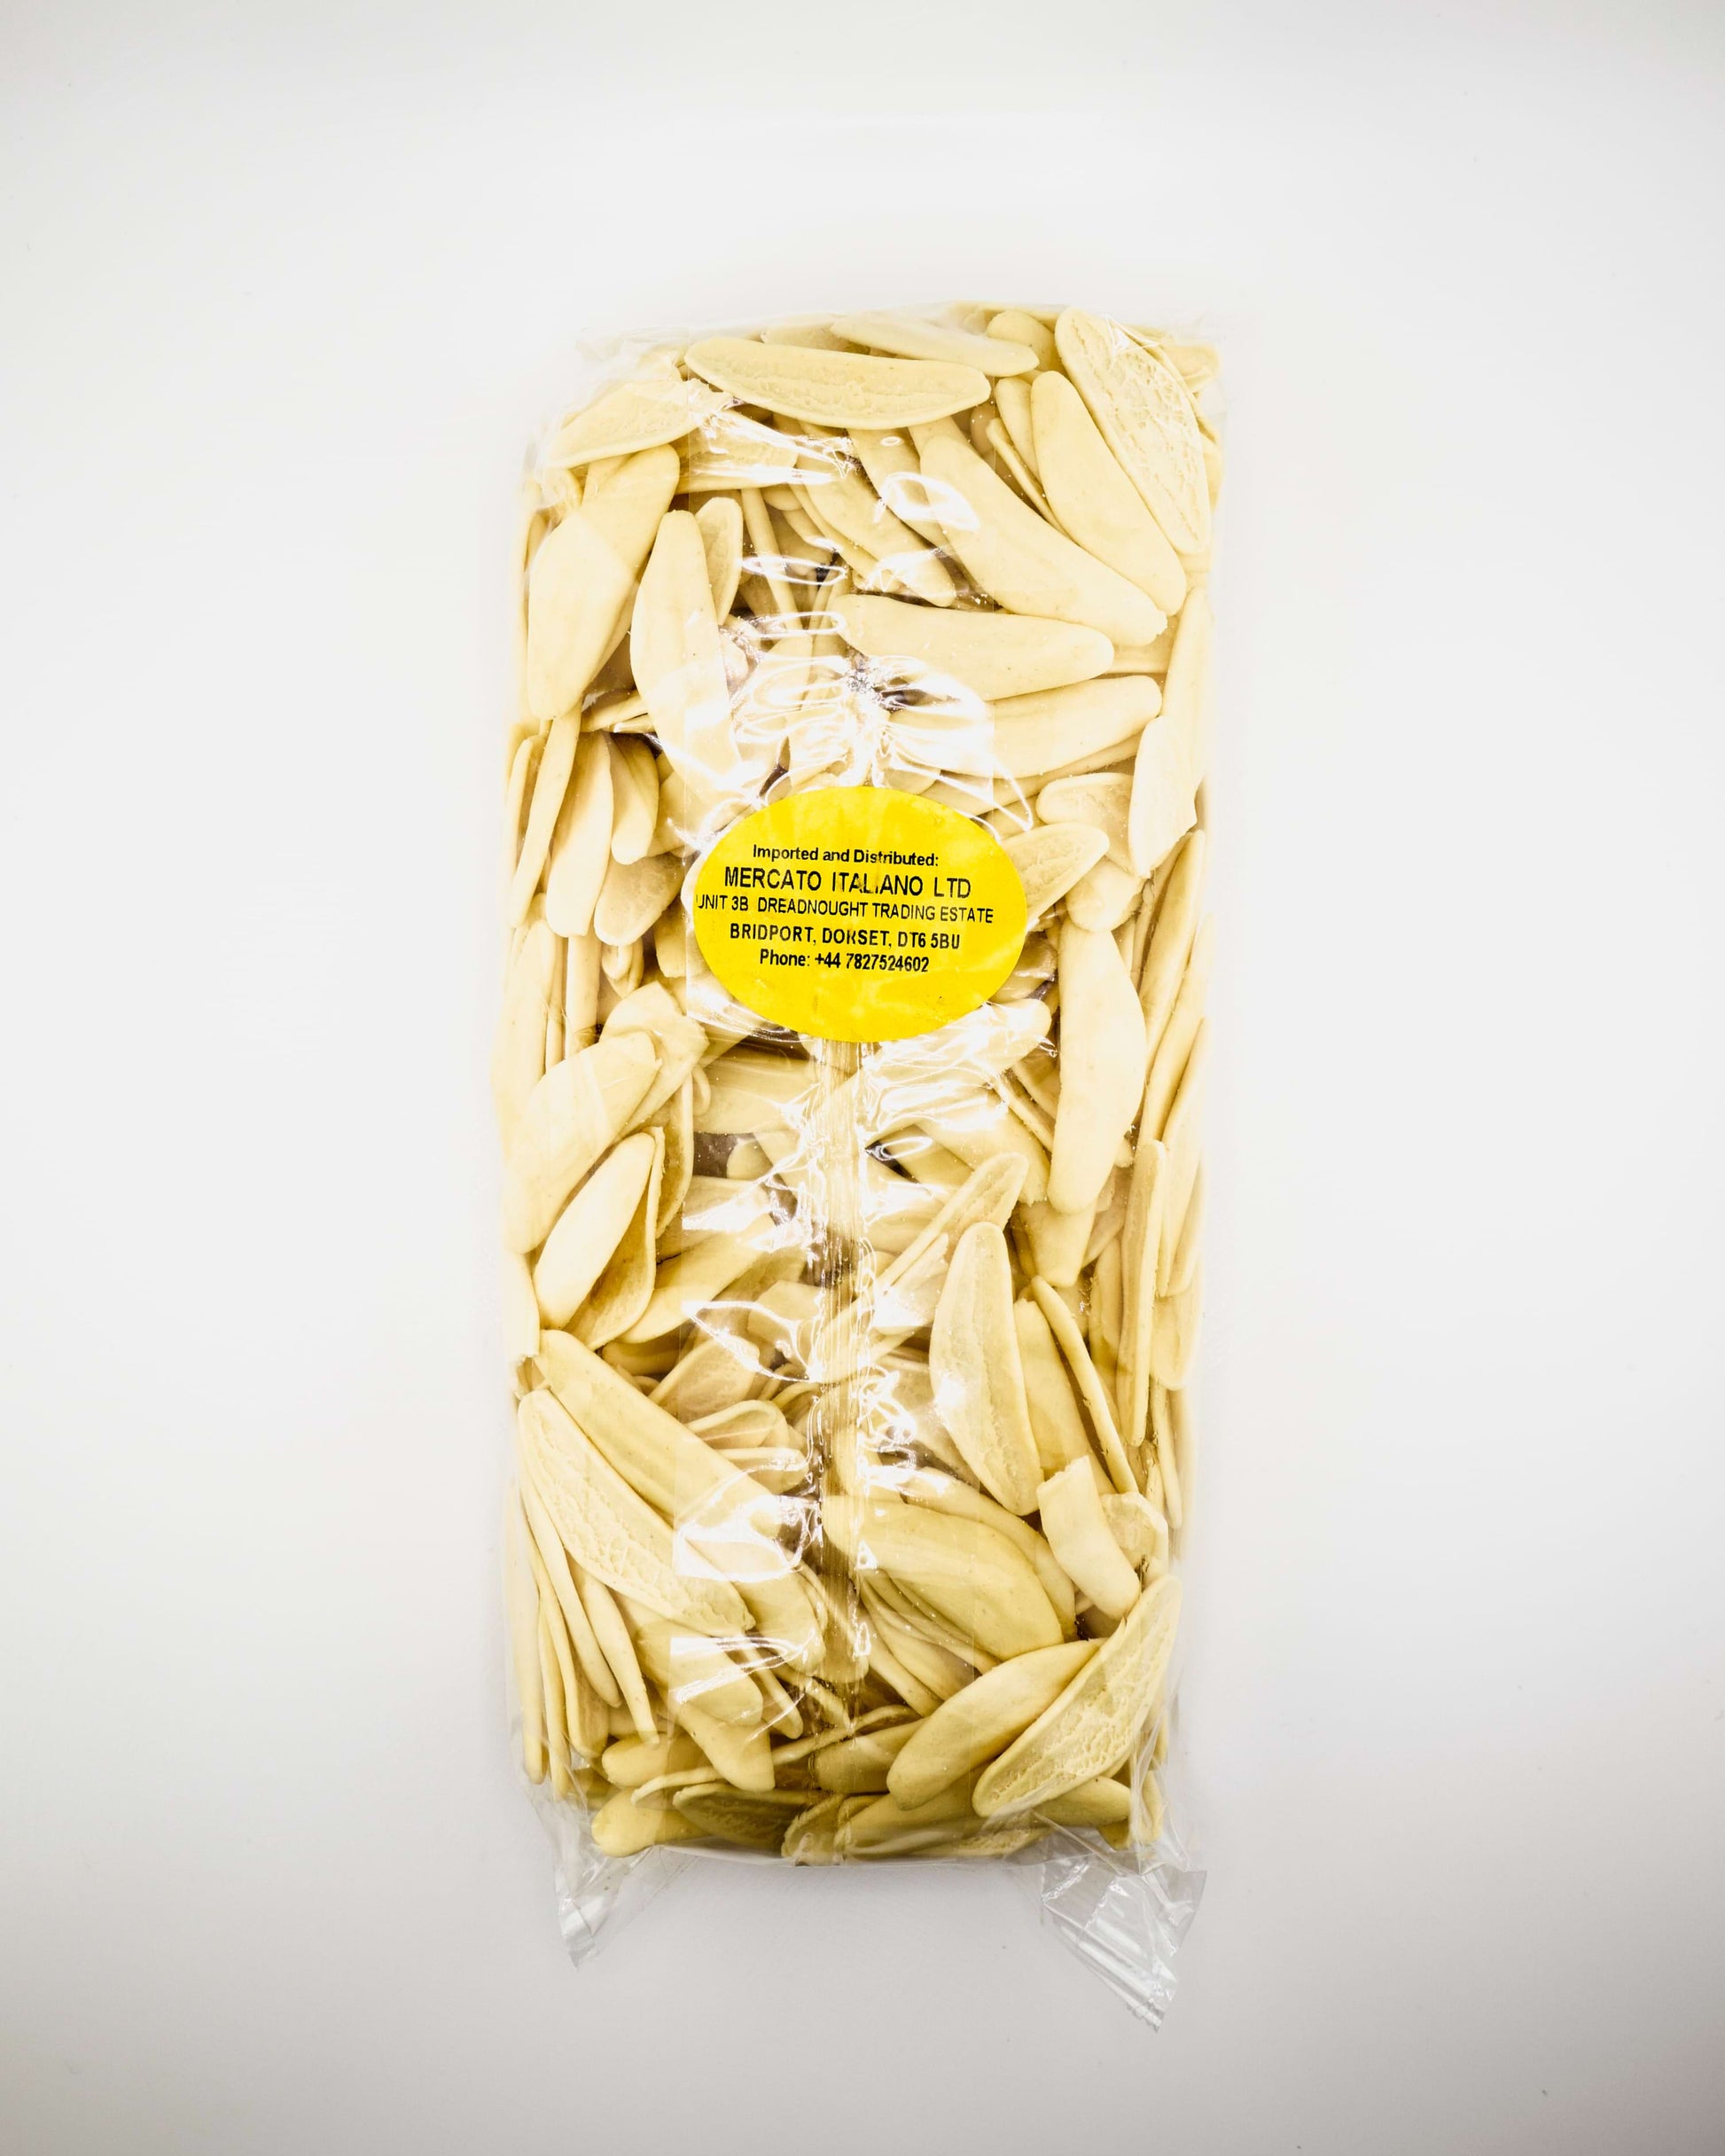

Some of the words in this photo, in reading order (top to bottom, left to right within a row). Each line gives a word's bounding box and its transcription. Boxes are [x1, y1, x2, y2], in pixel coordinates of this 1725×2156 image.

[752, 844, 818, 863] Imported
[822, 848, 850, 863] and
[853, 848, 939, 867] Distributed:
[723, 865, 822, 893] MERCATO
[831, 871, 924, 897] ITALIANO
[933, 876, 972, 899] LTD
[731, 895, 749, 911] 3B
[757, 896, 869, 918] DREADNOUGHT
[872, 902, 936, 921] TRADING
[940, 906, 995, 924] ESTATE
[730, 922, 817, 946] BRIDPORT,
[822, 927, 893, 949] DORSET,
[897, 931, 927, 949] DT6
[930, 933, 960, 949] 5BU
[760, 948, 811, 967] Phone:
[814, 951, 841, 969] +44
[846, 953, 930, 973] 7827524602
